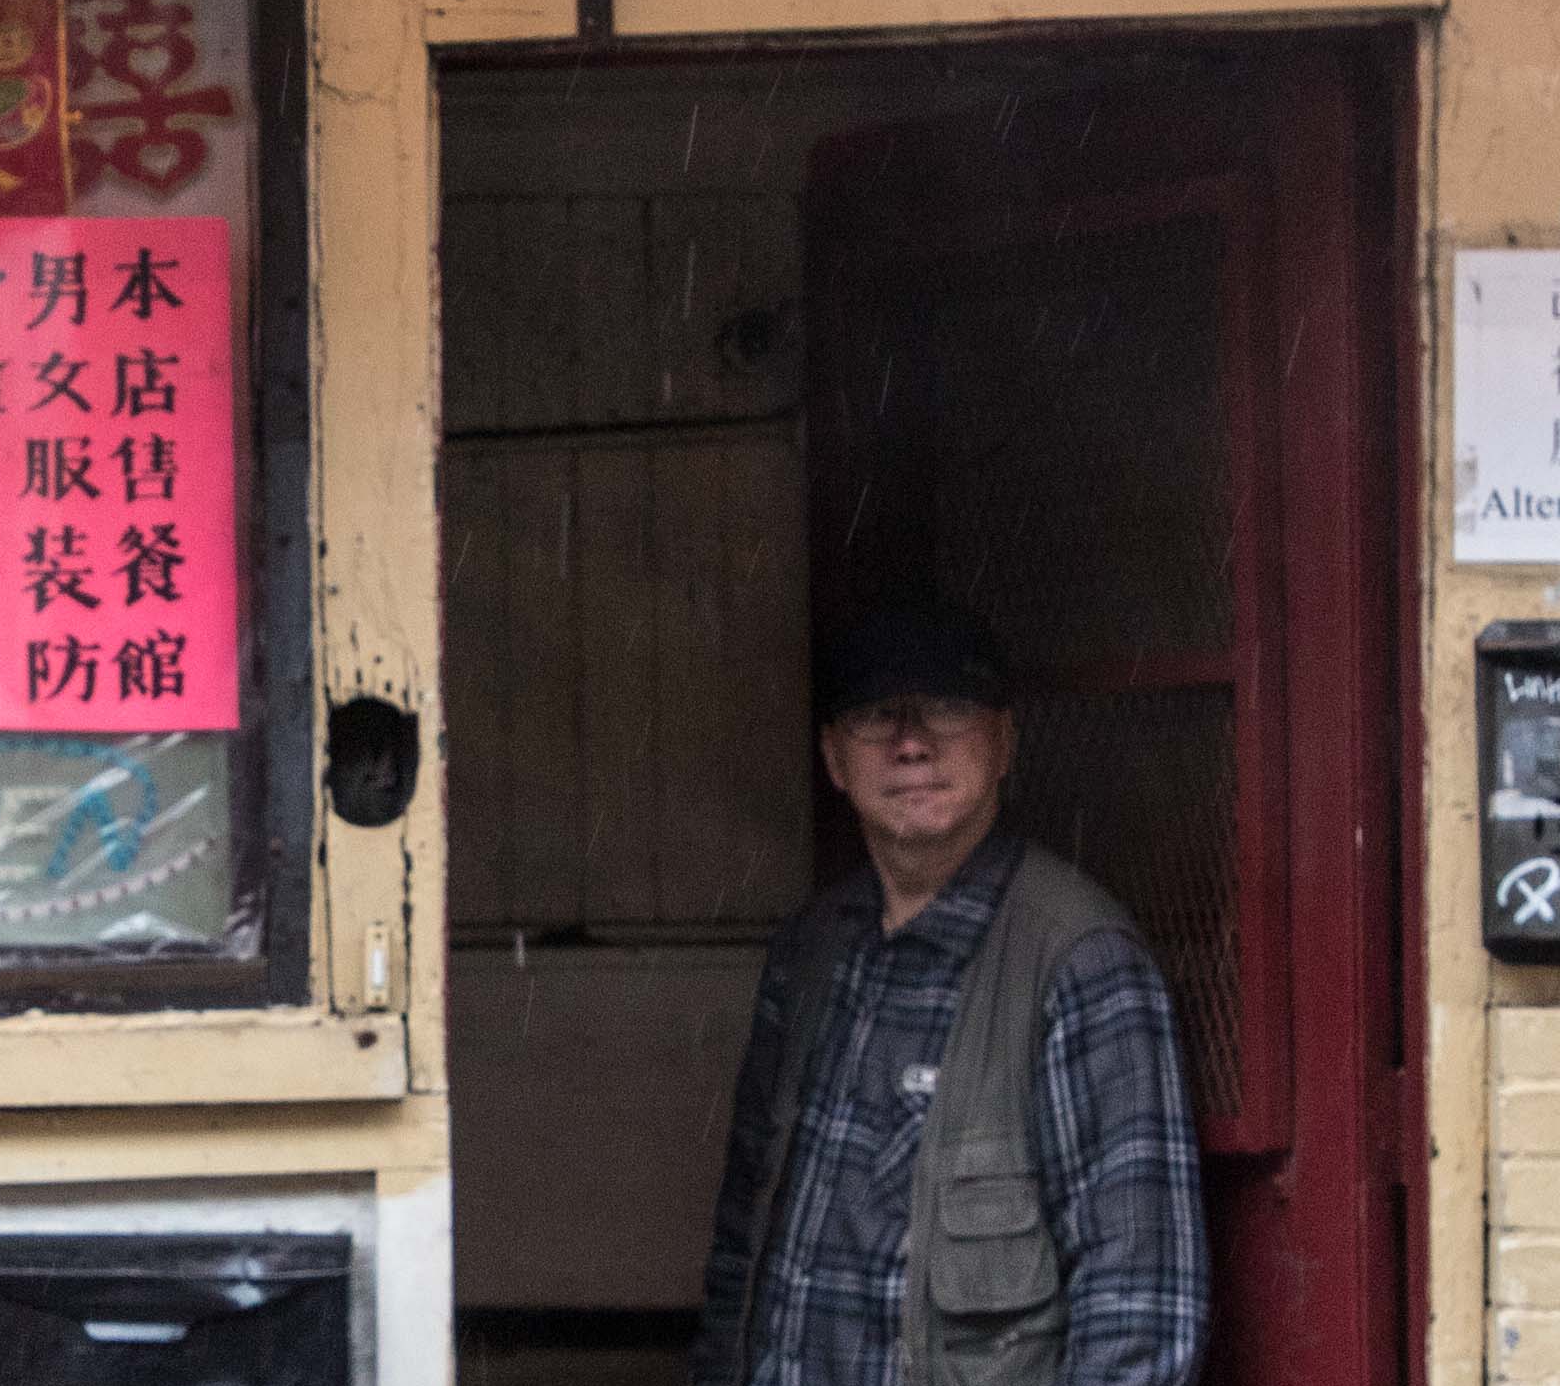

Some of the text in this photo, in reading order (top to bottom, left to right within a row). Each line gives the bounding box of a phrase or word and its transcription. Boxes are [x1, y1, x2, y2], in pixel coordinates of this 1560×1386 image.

[108, 245, 186, 703] 本店售餐館
